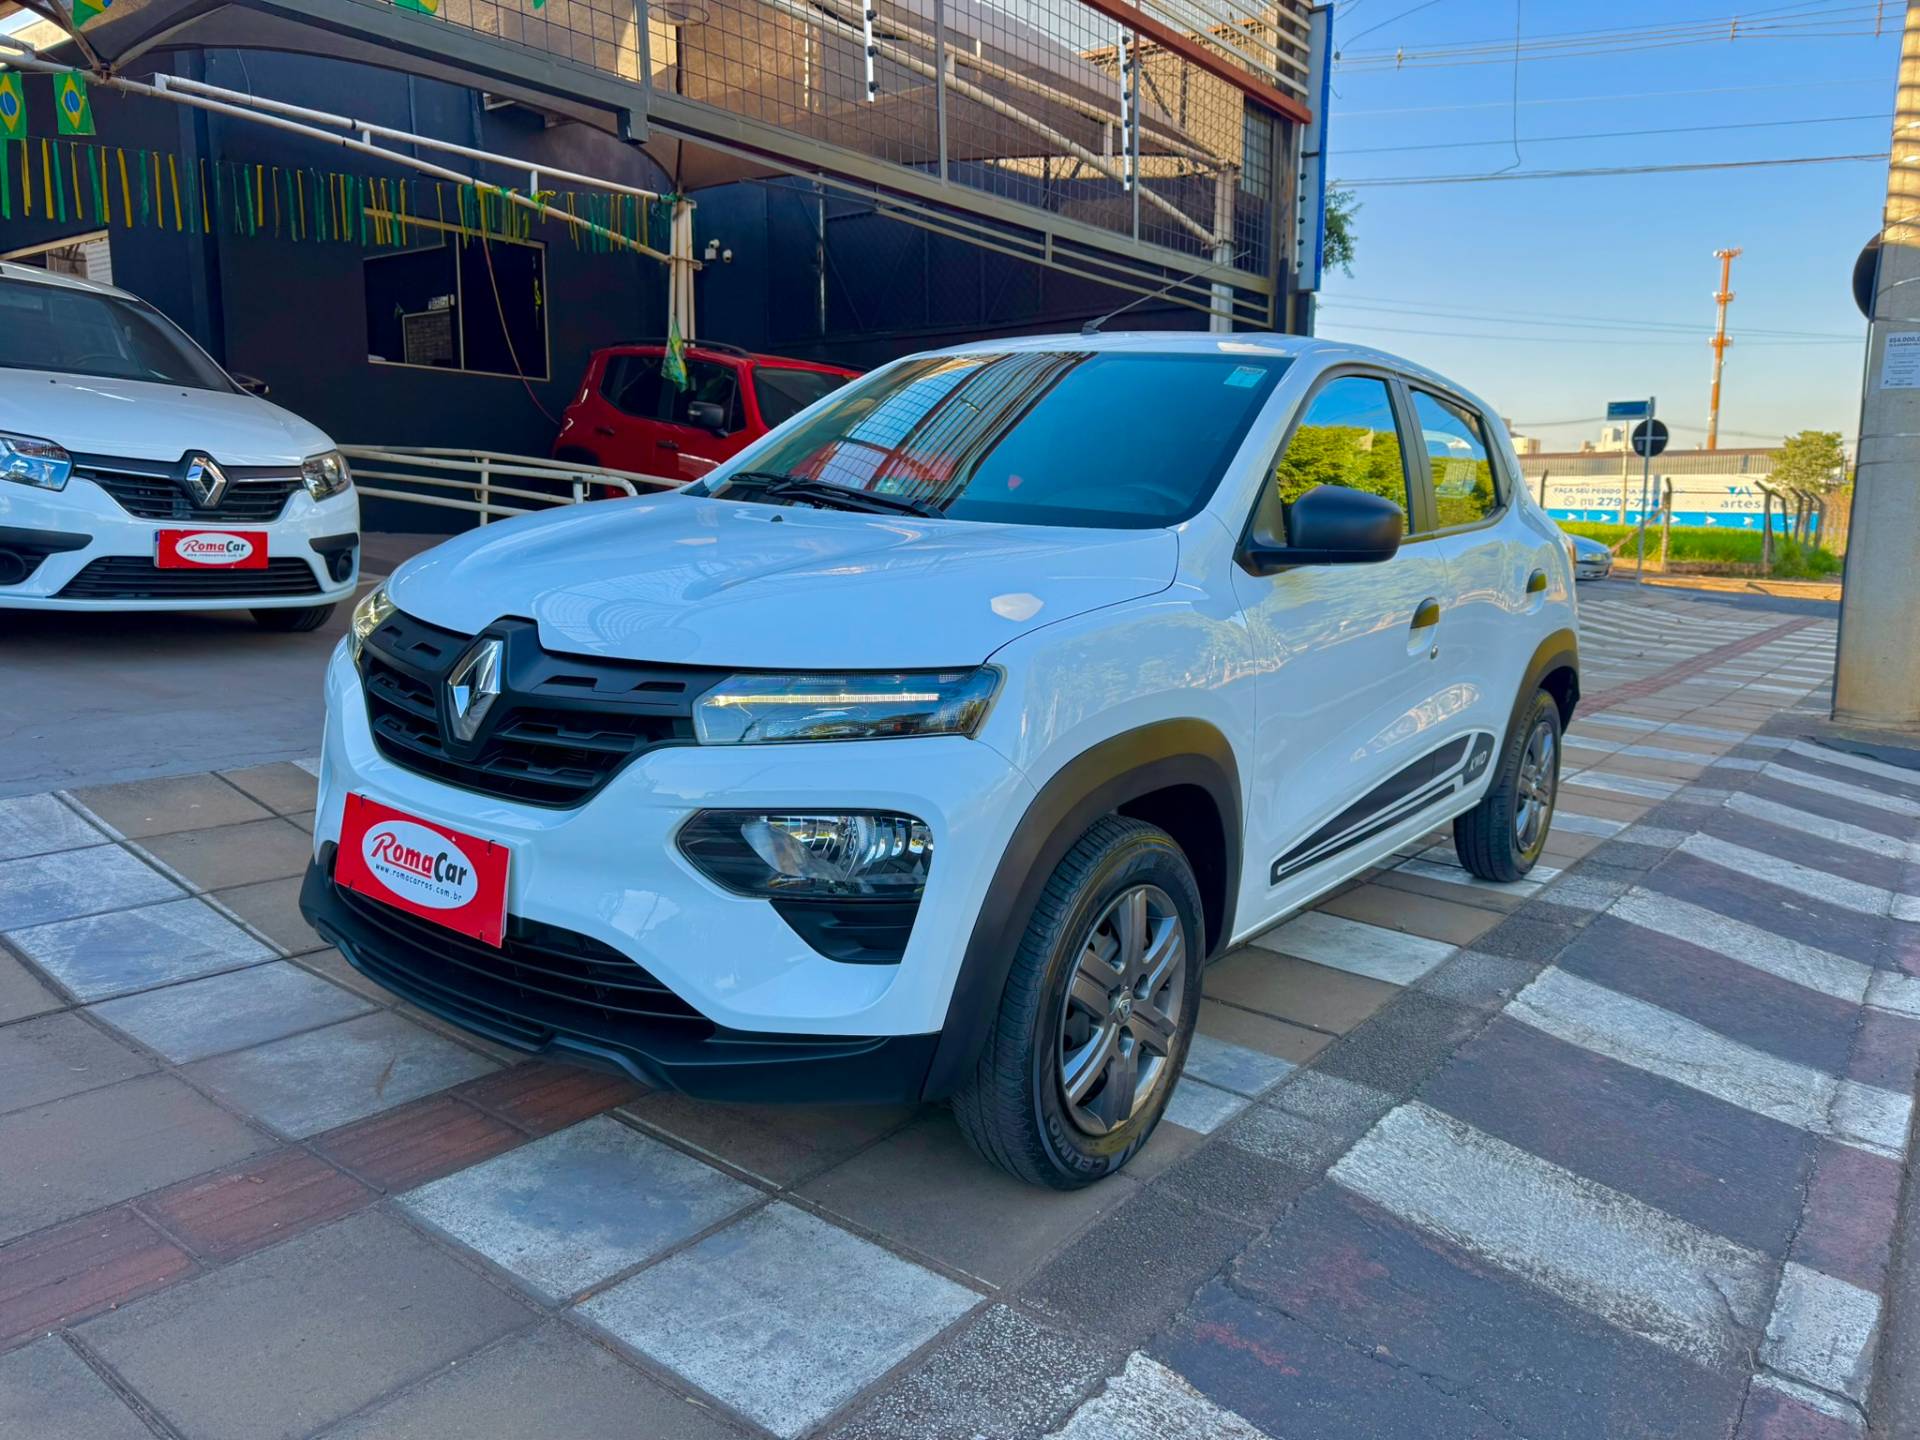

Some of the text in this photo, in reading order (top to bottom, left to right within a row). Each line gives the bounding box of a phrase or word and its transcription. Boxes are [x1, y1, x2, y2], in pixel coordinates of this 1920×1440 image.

[183, 540, 246, 552] RomaCar
[371, 831, 467, 886] RomaCar
[375, 863, 462, 902] www.romacarros.com.br
